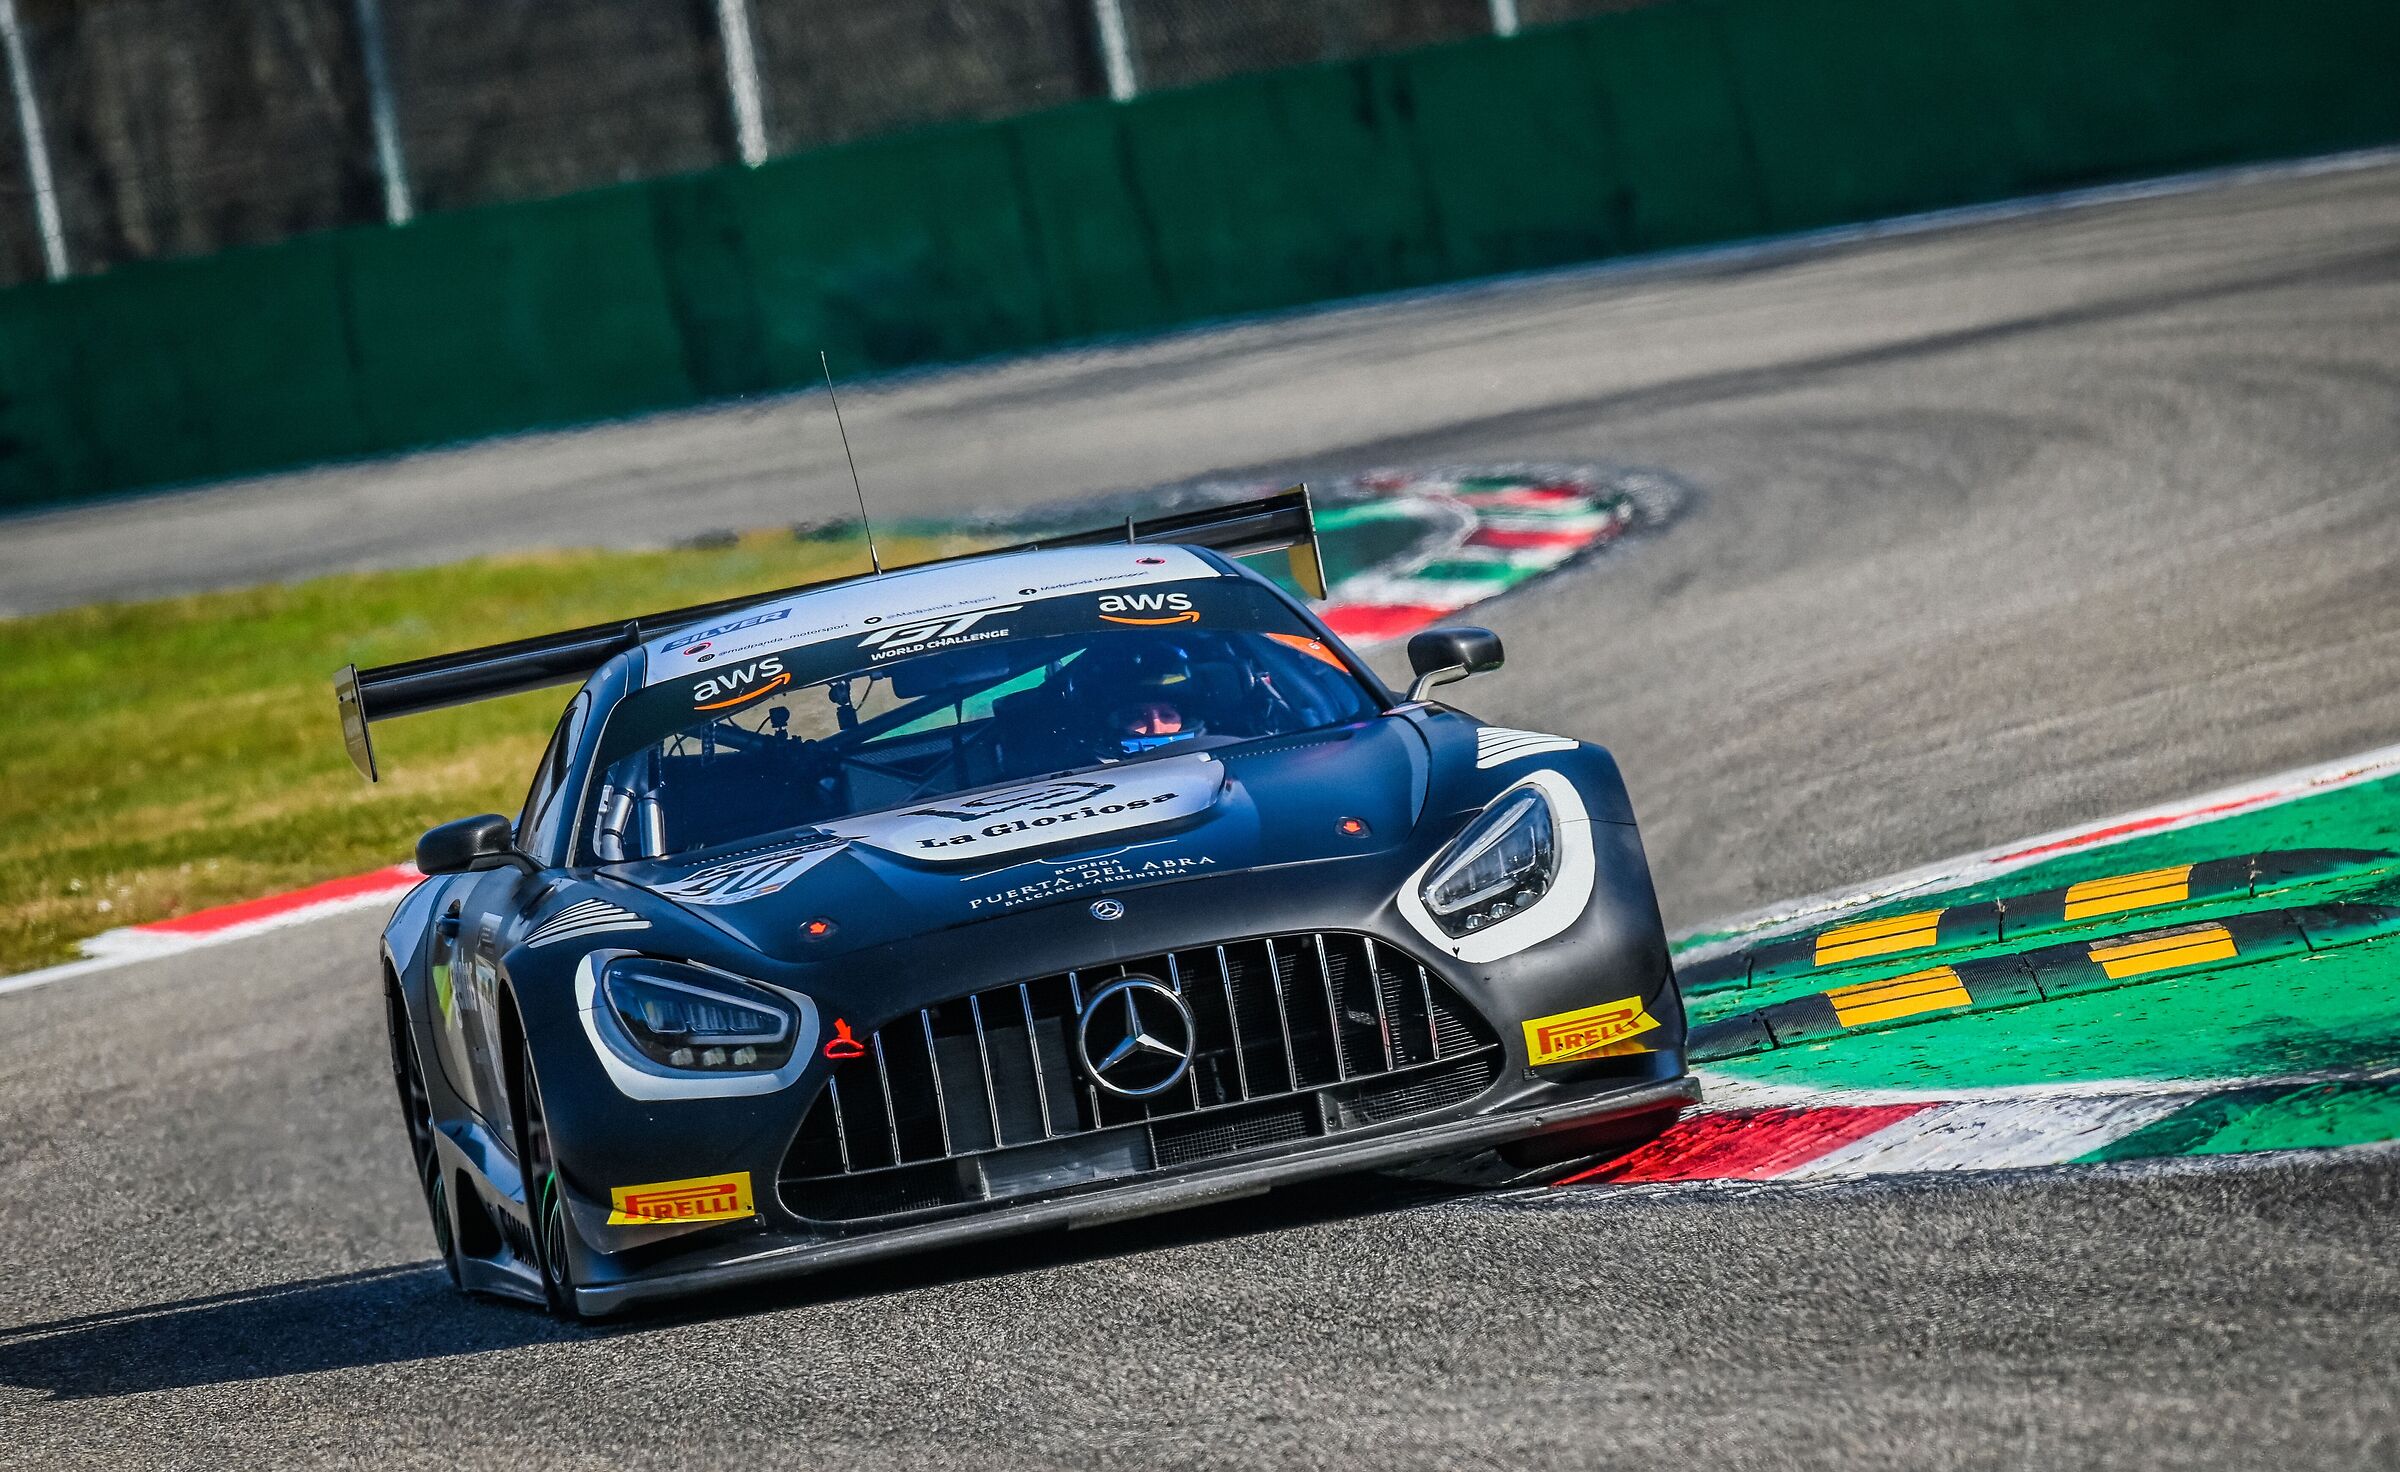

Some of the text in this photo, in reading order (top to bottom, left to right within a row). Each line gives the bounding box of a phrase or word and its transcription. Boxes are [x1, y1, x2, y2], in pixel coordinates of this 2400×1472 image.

[1098, 592, 1194, 613] aws
[666, 611, 785, 650] SILVER
[857, 604, 1025, 651] GT
[871, 628, 1010, 662] WORLD CHALLENGE
[692, 656, 784, 702] aws
[916, 791, 1180, 850] La Gloriosa
[967, 855, 1218, 910] PUERTA DEL ABRA
[1054, 858, 1122, 875] BODEGA
[1004, 868, 1188, 909] BALCARCE-ARGENTINA
[1536, 1008, 1641, 1056] PIRELLI
[623, 1183, 739, 1220] PIRELLI
